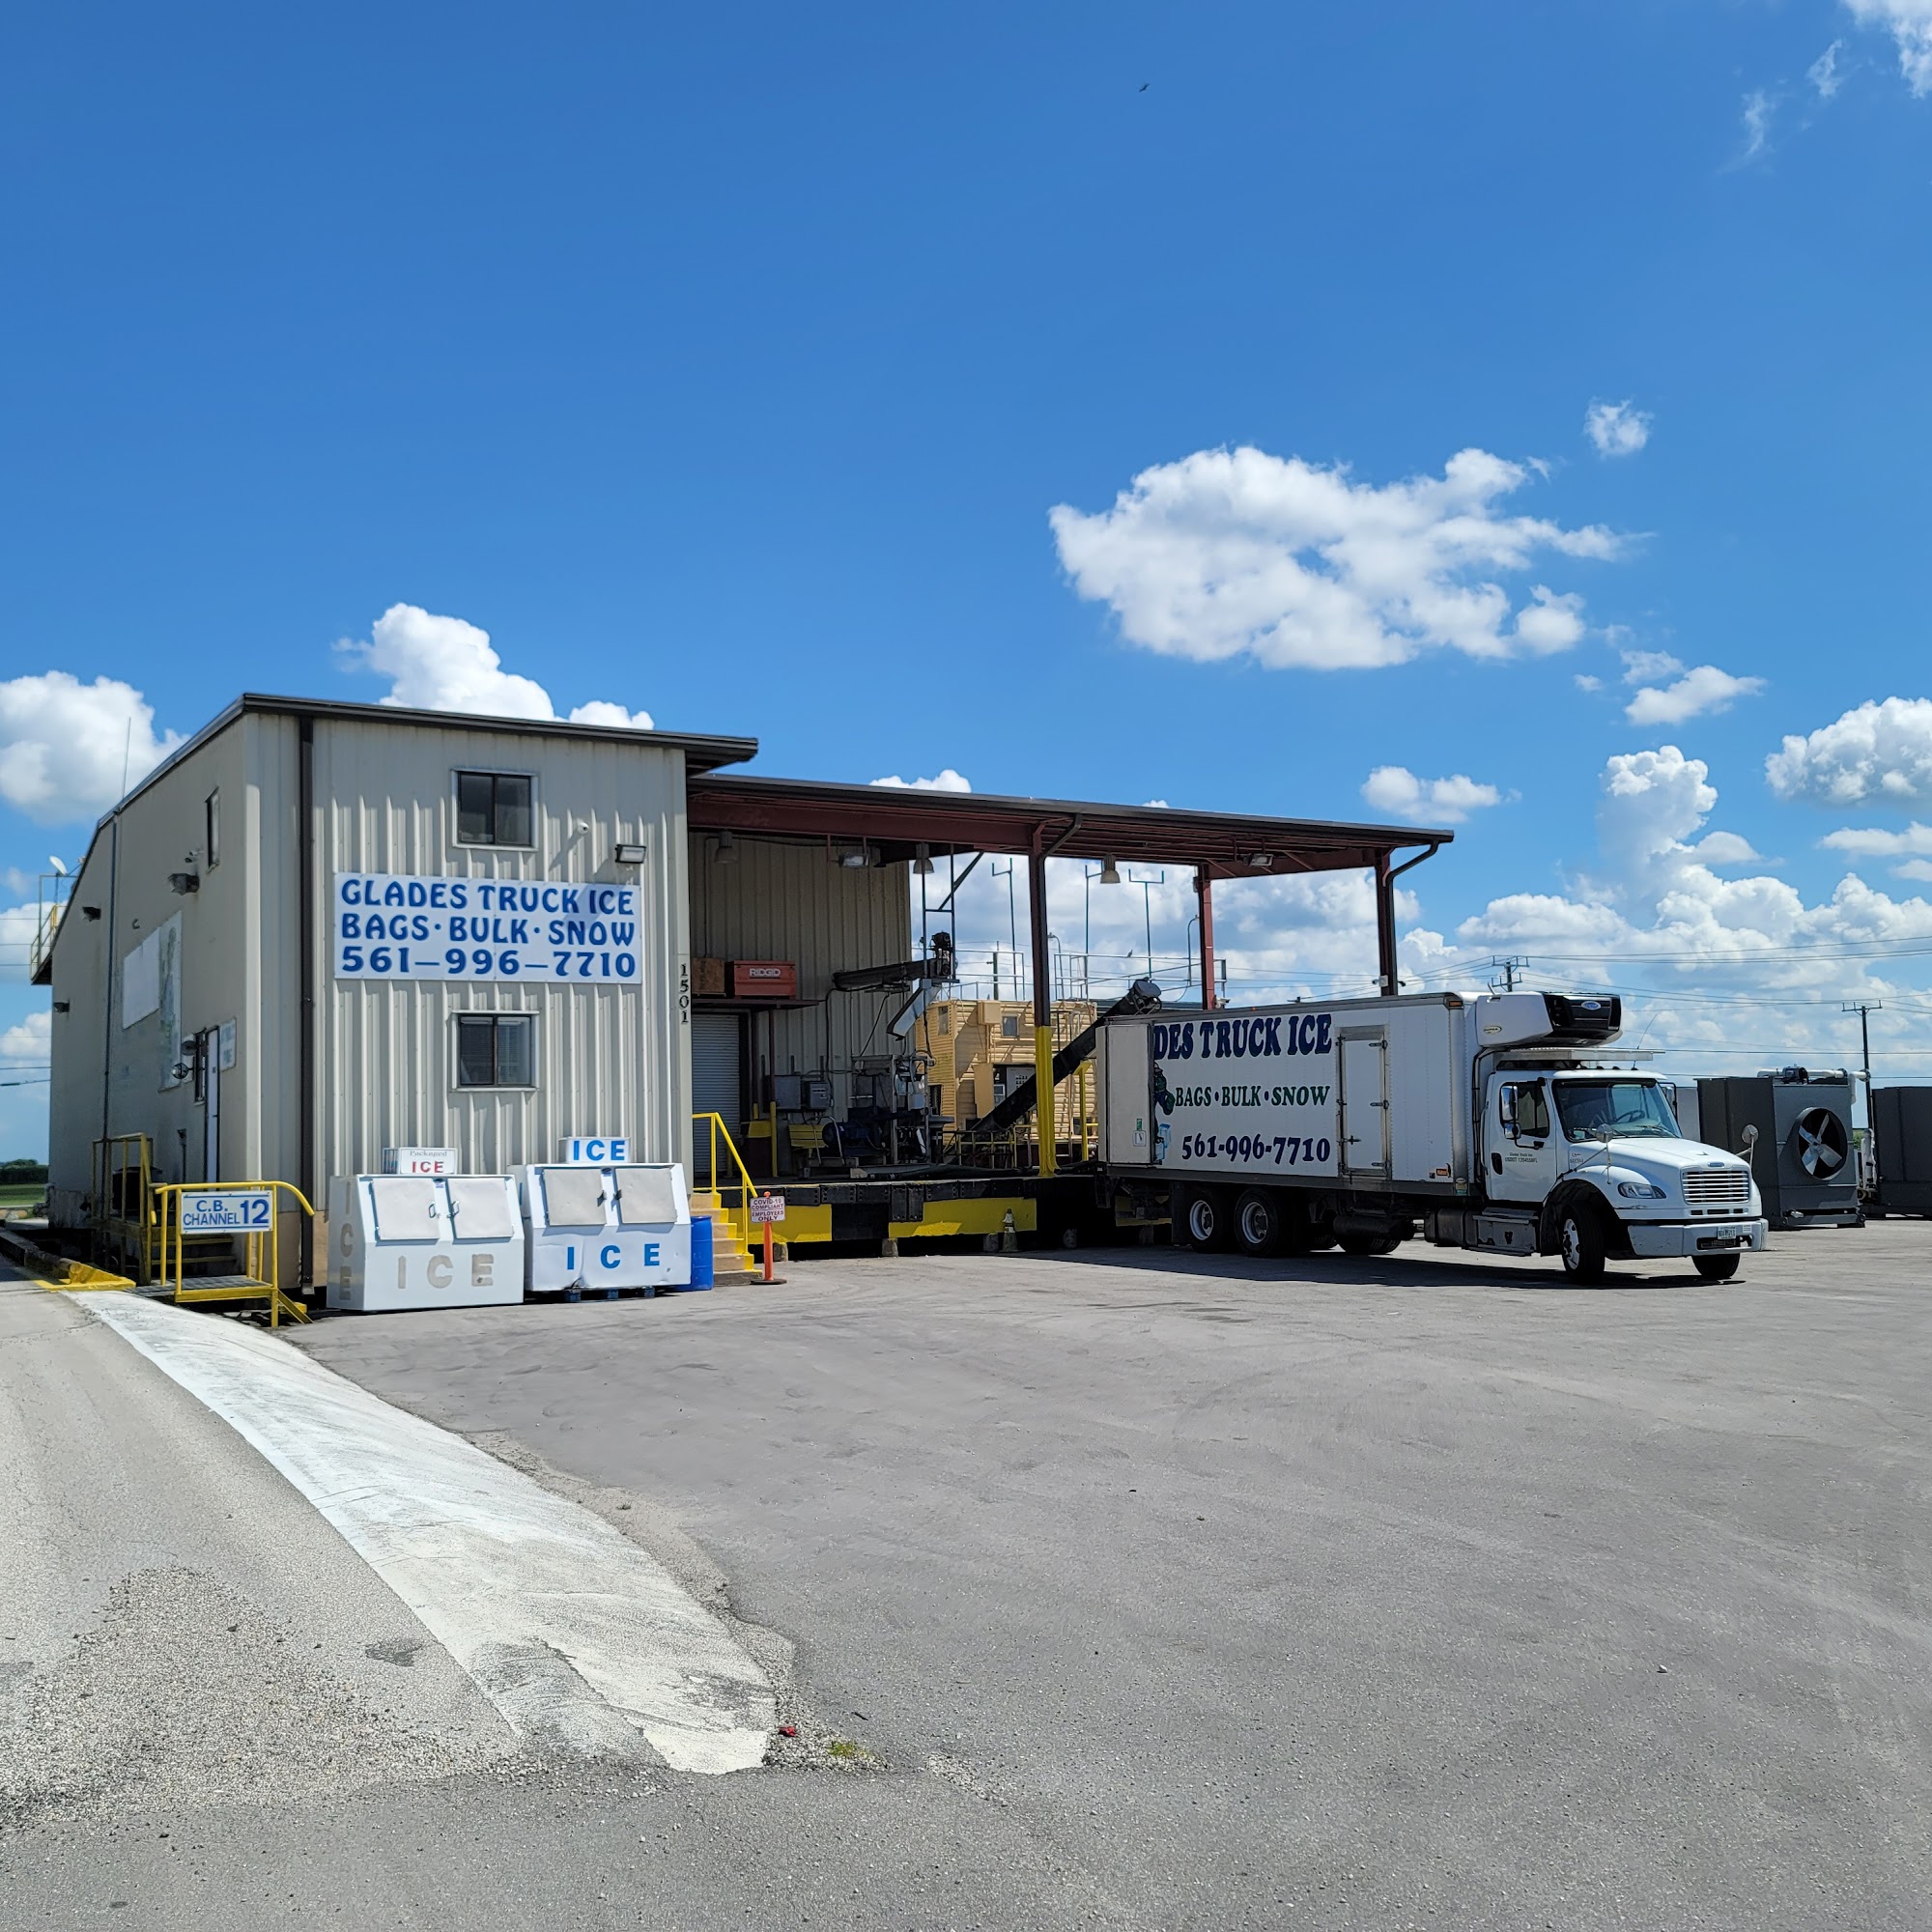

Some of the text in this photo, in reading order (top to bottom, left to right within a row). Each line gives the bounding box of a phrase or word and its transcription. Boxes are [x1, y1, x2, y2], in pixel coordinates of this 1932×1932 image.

[341, 879, 634, 915] GLADES TRUCK ICE
[549, 920, 635, 947] SNOW
[749, 968, 781, 978] RIDGID
[679, 963, 690, 1023] 1501
[1200, 1017, 1281, 1059] TRUCK
[1288, 1014, 1332, 1056] ICE
[1271, 1086, 1330, 1106] SNOW
[573, 1140, 626, 1161] ICE
[1182, 1133, 1331, 1165] 561-996-7710
[412, 1161, 444, 1174] ICE
[183, 1199, 270, 1226] CHANNEL 12
[196, 1200, 228, 1212] C.B.
[567, 1242, 661, 1270] ICE
[398, 1254, 494, 1290] ICE
